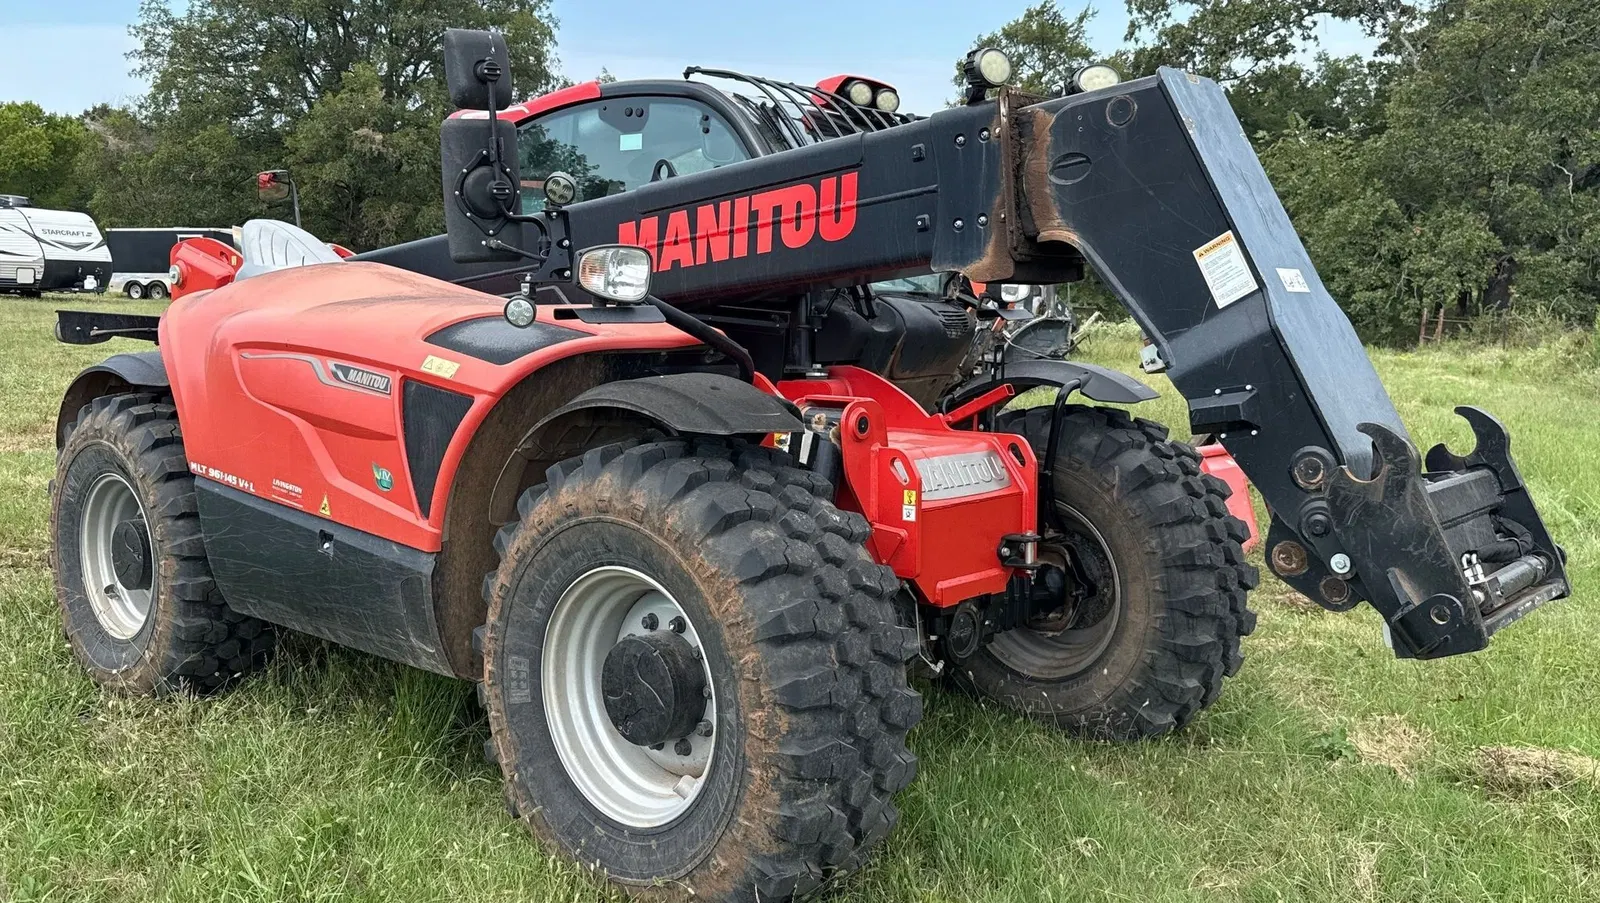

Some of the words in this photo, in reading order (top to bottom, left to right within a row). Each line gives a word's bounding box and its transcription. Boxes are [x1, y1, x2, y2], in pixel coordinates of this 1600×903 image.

[618, 171, 858, 273] MANITOU
[41, 228, 85, 238] STARCRAFT
[1204, 236, 1231, 254] WARNING
[347, 369, 388, 389] MANITOU
[190, 461, 207, 474] MLT
[249, 482, 256, 492] L
